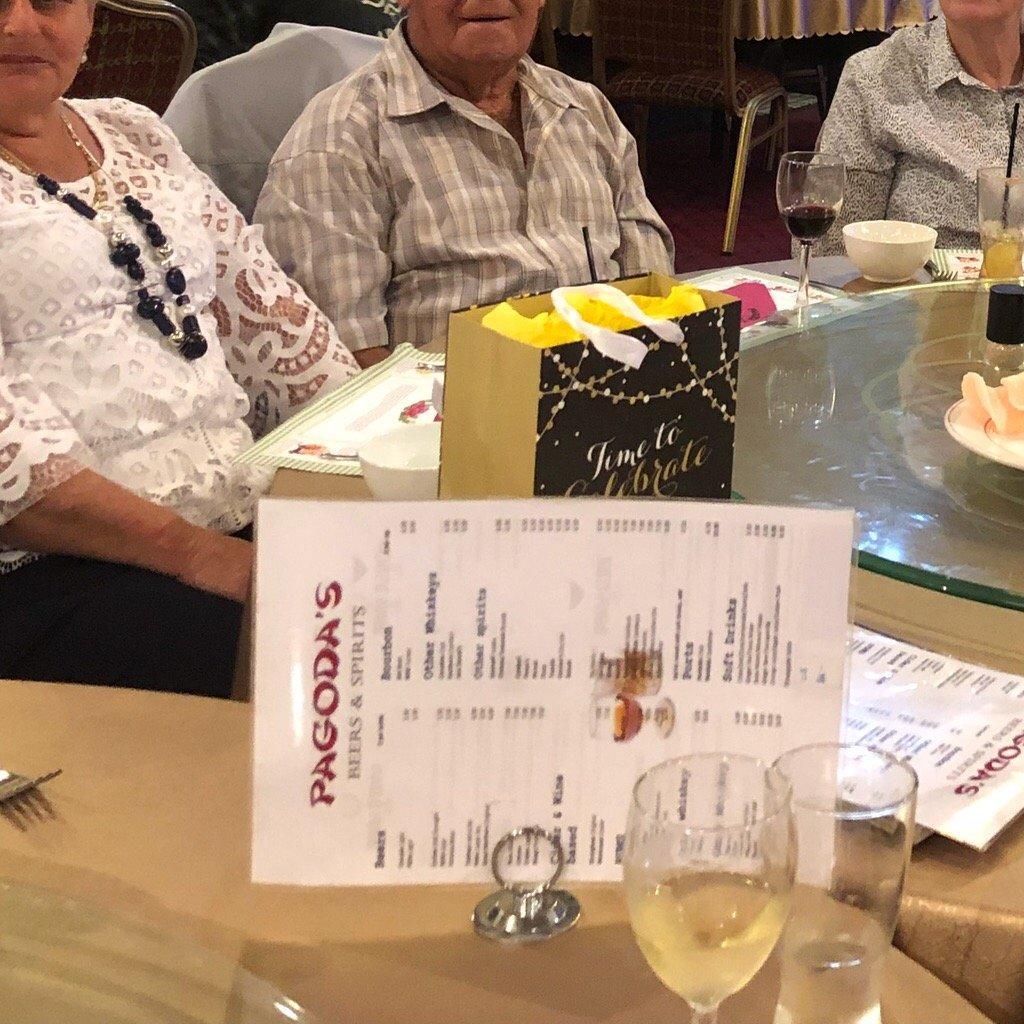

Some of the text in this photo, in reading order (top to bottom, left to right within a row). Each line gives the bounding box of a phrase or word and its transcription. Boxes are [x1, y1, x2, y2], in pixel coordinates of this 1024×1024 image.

[564, 435, 713, 497] lebrate
[586, 414, 685, 481] Time to
[310, 580, 343, 807] PAGODA'S
[348, 604, 367, 780] BEERS & SPIRITS
